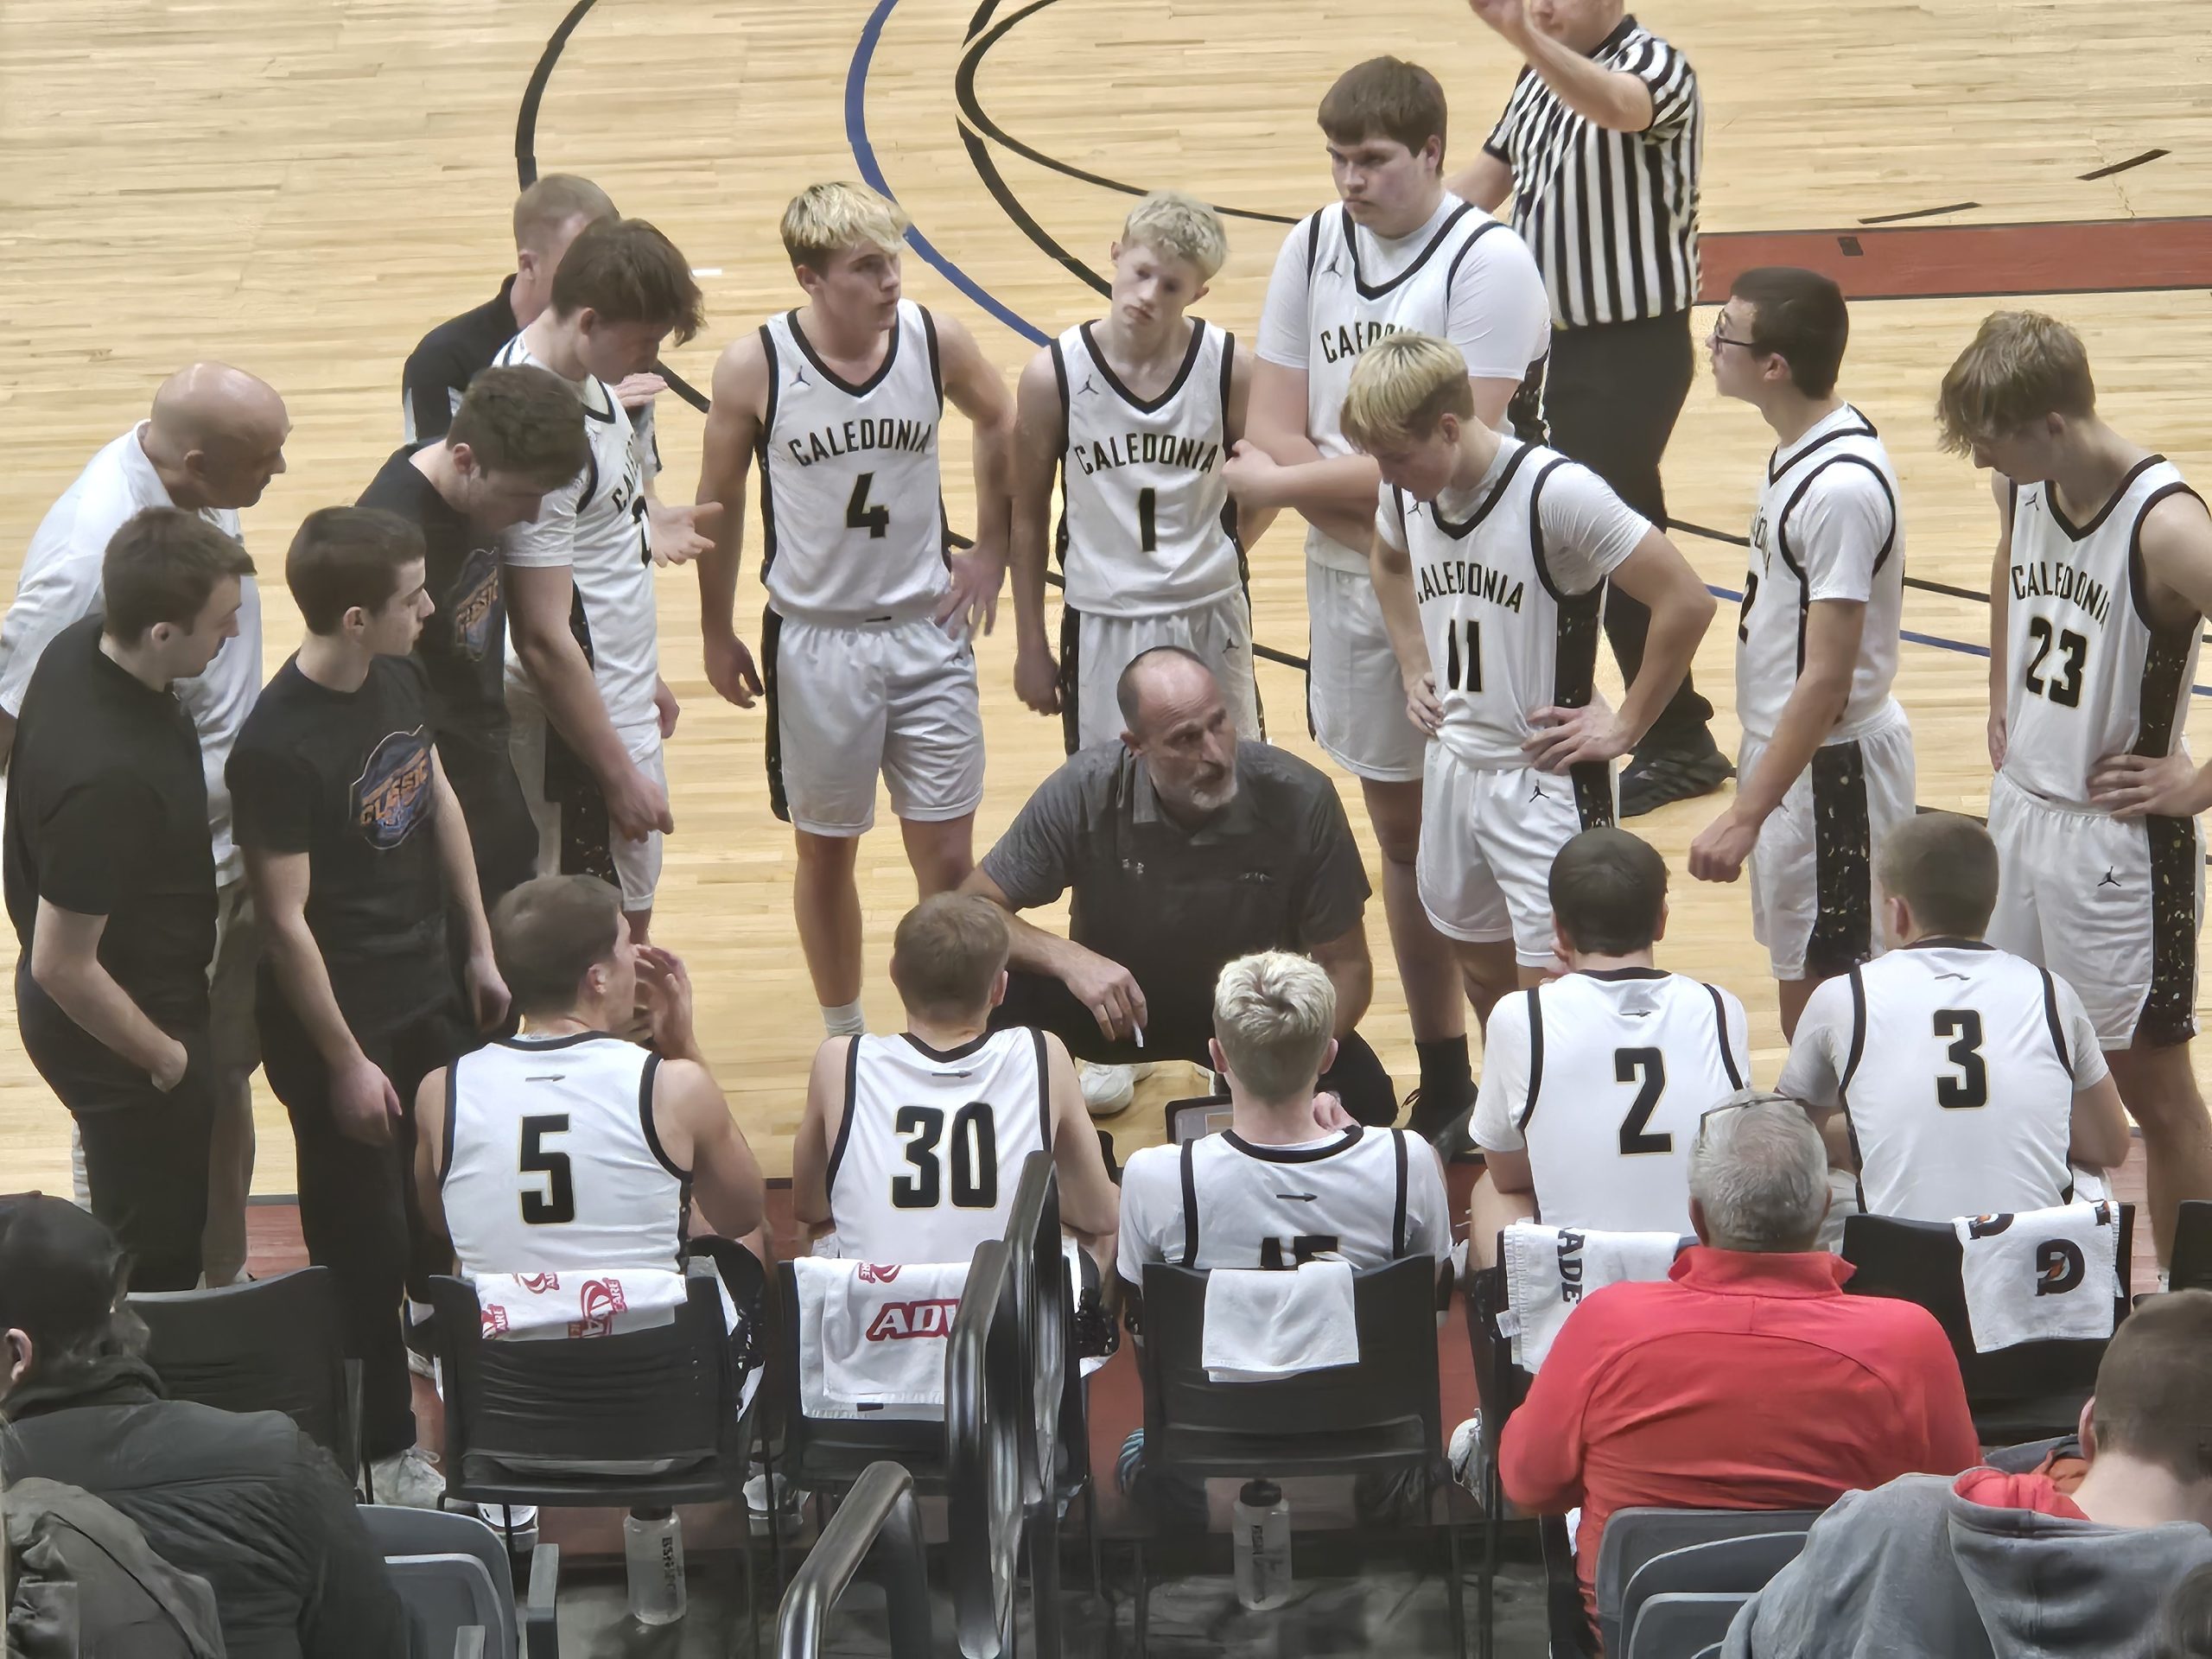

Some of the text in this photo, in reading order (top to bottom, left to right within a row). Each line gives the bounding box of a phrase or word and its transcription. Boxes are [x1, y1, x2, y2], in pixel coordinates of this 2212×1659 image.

[787, 418, 931, 467] CALEDONIA
[1074, 433, 1218, 474] CALEDONIA
[845, 472, 890, 540] 4
[1139, 487, 1157, 552] 1
[1418, 561, 1524, 613] ALEDONIA
[1447, 619, 1483, 692] 11
[2025, 616, 2088, 708] 23
[1933, 1008, 1987, 1109] 3
[1614, 1046, 1673, 1155] 2
[519, 1113, 575, 1225] 5
[892, 1101, 998, 1209] 30
